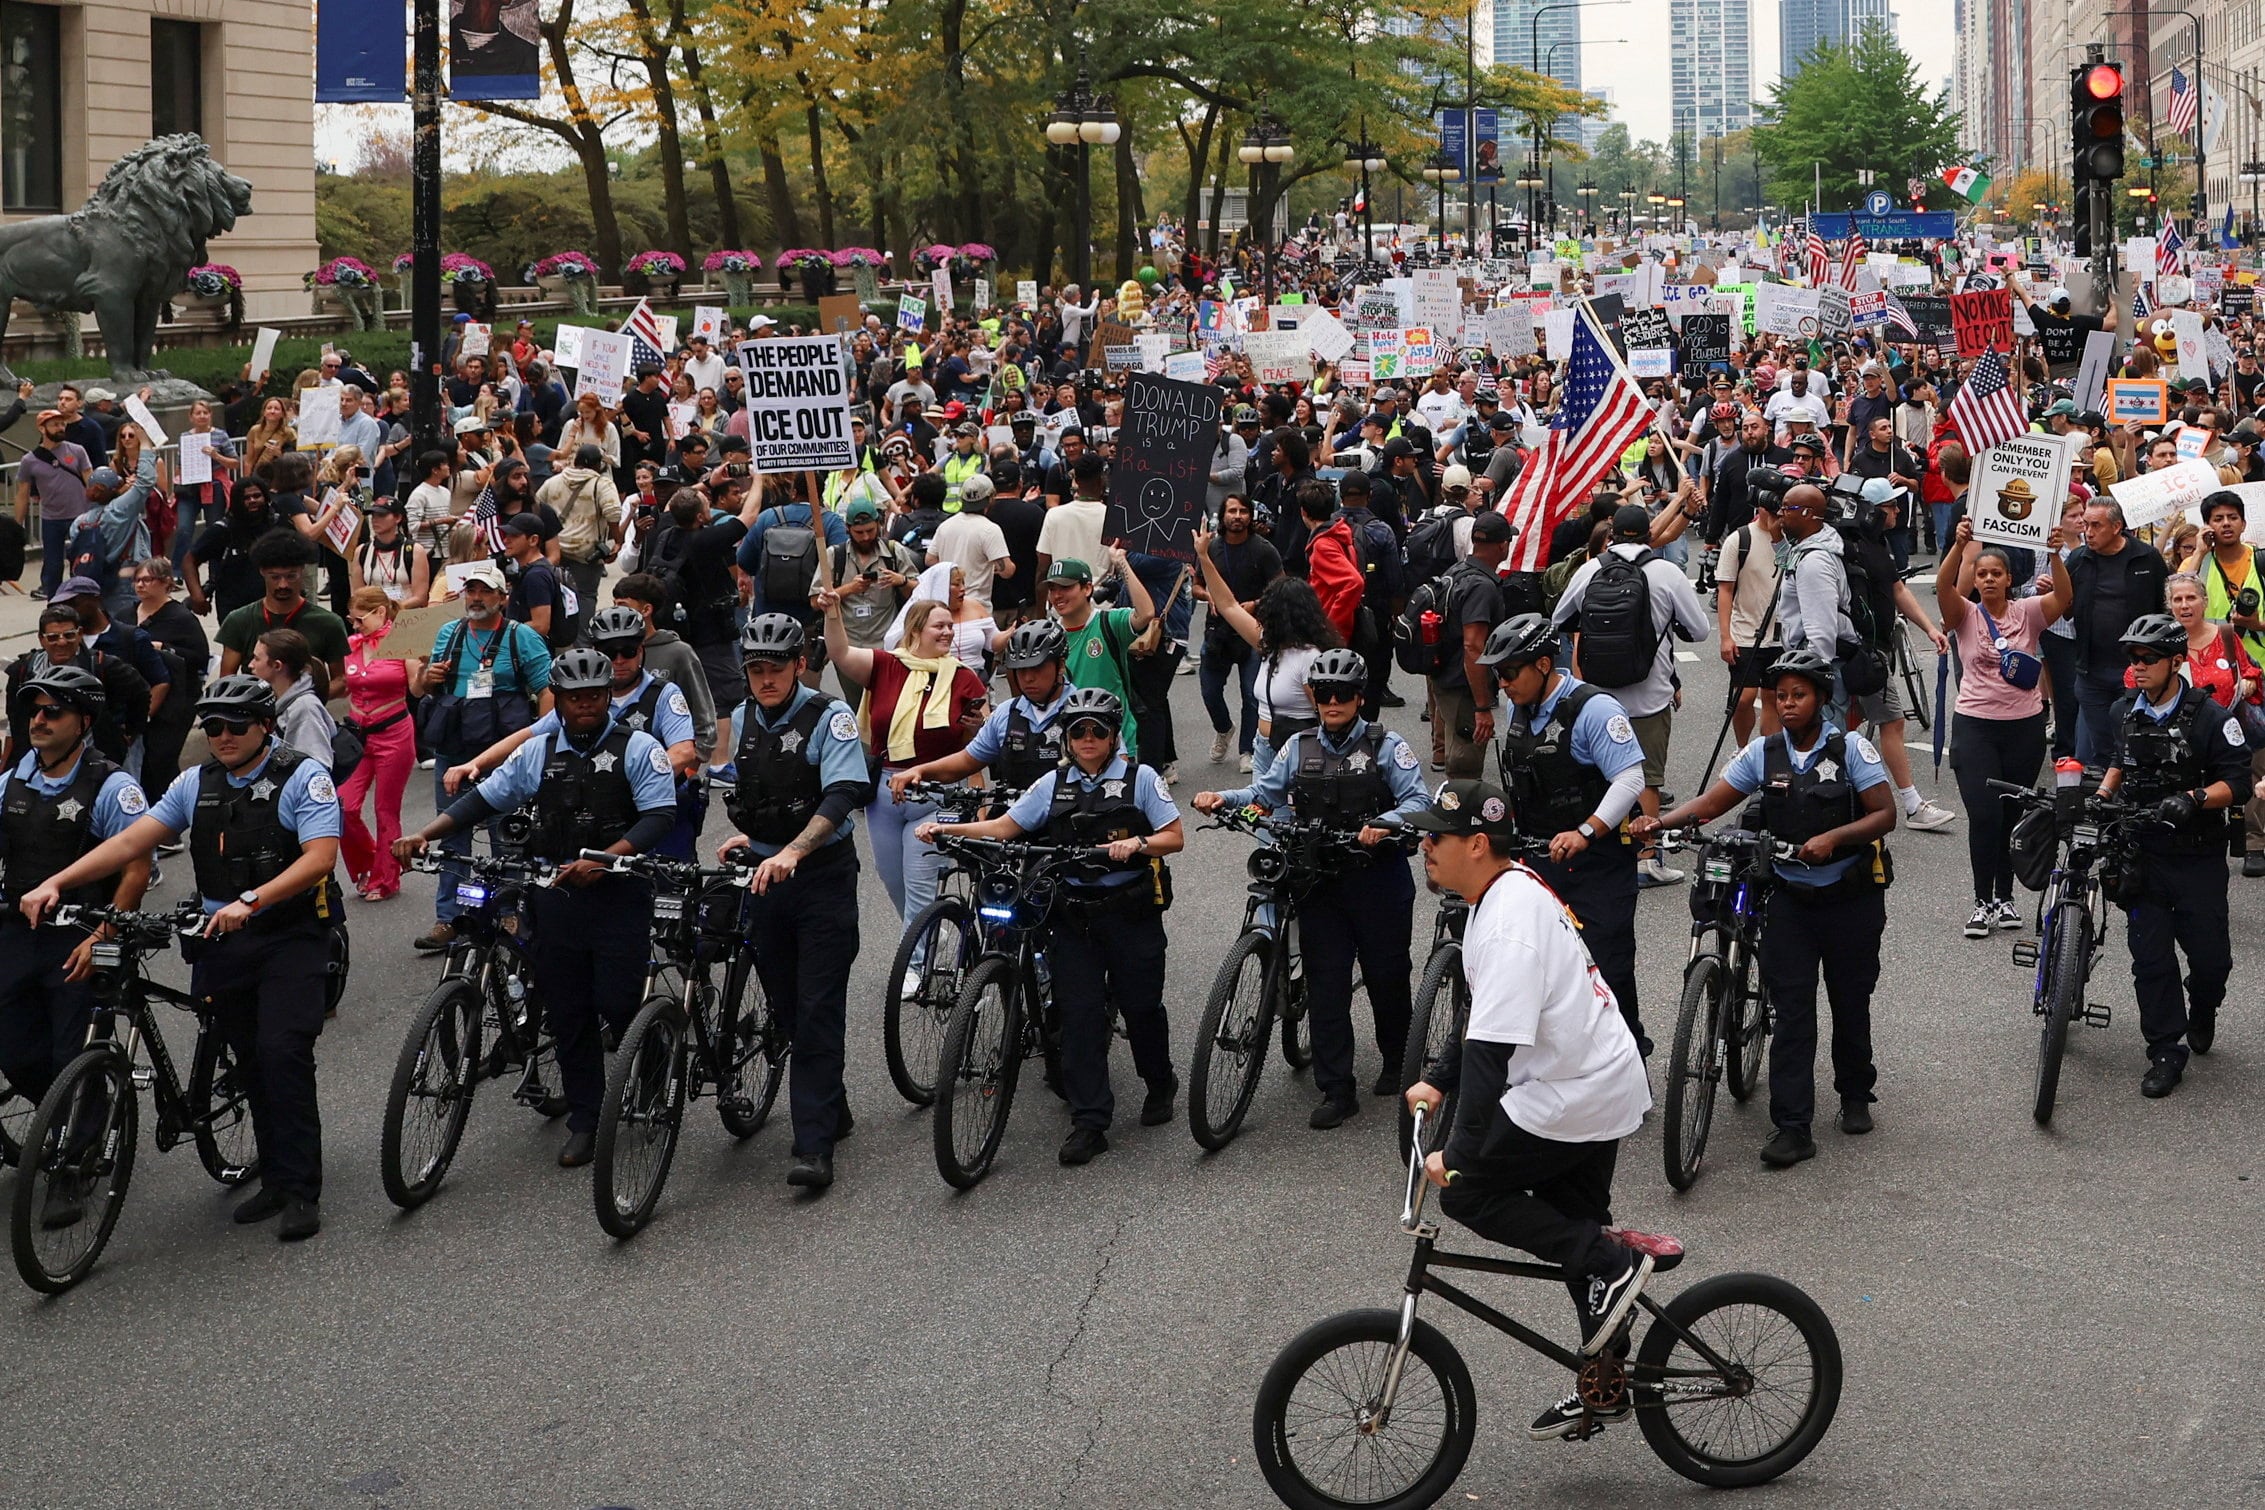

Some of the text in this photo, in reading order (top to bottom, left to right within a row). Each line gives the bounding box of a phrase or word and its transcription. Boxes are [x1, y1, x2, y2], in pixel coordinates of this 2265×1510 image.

[1874, 196, 1886, 213] P
[1428, 272, 1440, 280] 911
[1661, 285, 1681, 300] ICE
[1895, 285, 1931, 294] STOP THE
[902, 296, 924, 313] FUCK
[1855, 293, 1878, 306] STOP
[1360, 307, 1398, 317] STOP THE
[1853, 302, 1884, 314] TRUMP
[1953, 292, 2010, 325] NO KING
[900, 310, 923, 330] TRUMP
[1686, 316, 1713, 336] GOD
[1372, 331, 1398, 340] Hate
[1957, 326, 1984, 353] ICE
[742, 344, 838, 368] THE PEOPLE
[1410, 345, 1433, 357] Any
[1691, 347, 1730, 360] POWERFUL
[1109, 362, 1143, 370] CHICAGO
[1263, 367, 1294, 379] PEACE
[1684, 362, 1707, 379] FUCK
[581, 374, 597, 384] THEY
[748, 369, 841, 398] DEMAND
[1131, 381, 1216, 422] DONALD
[753, 407, 844, 441] ICE OUT
[1134, 411, 1200, 442] TRUMP
[756, 441, 850, 456] OF OUR COMMUNITIES!
[1167, 442, 1175, 450] a
[1994, 442, 2051, 458] REMEMBER
[760, 458, 776, 467] PARTY
[778, 458, 787, 466] FOR
[788, 457, 815, 465] SOCIALISM
[821, 455, 850, 464] LIBERATION
[1992, 453, 2050, 469] ONLY YOU
[1991, 464, 2048, 479] CAN PREVENT
[1983, 518, 2041, 537] FASCISM
